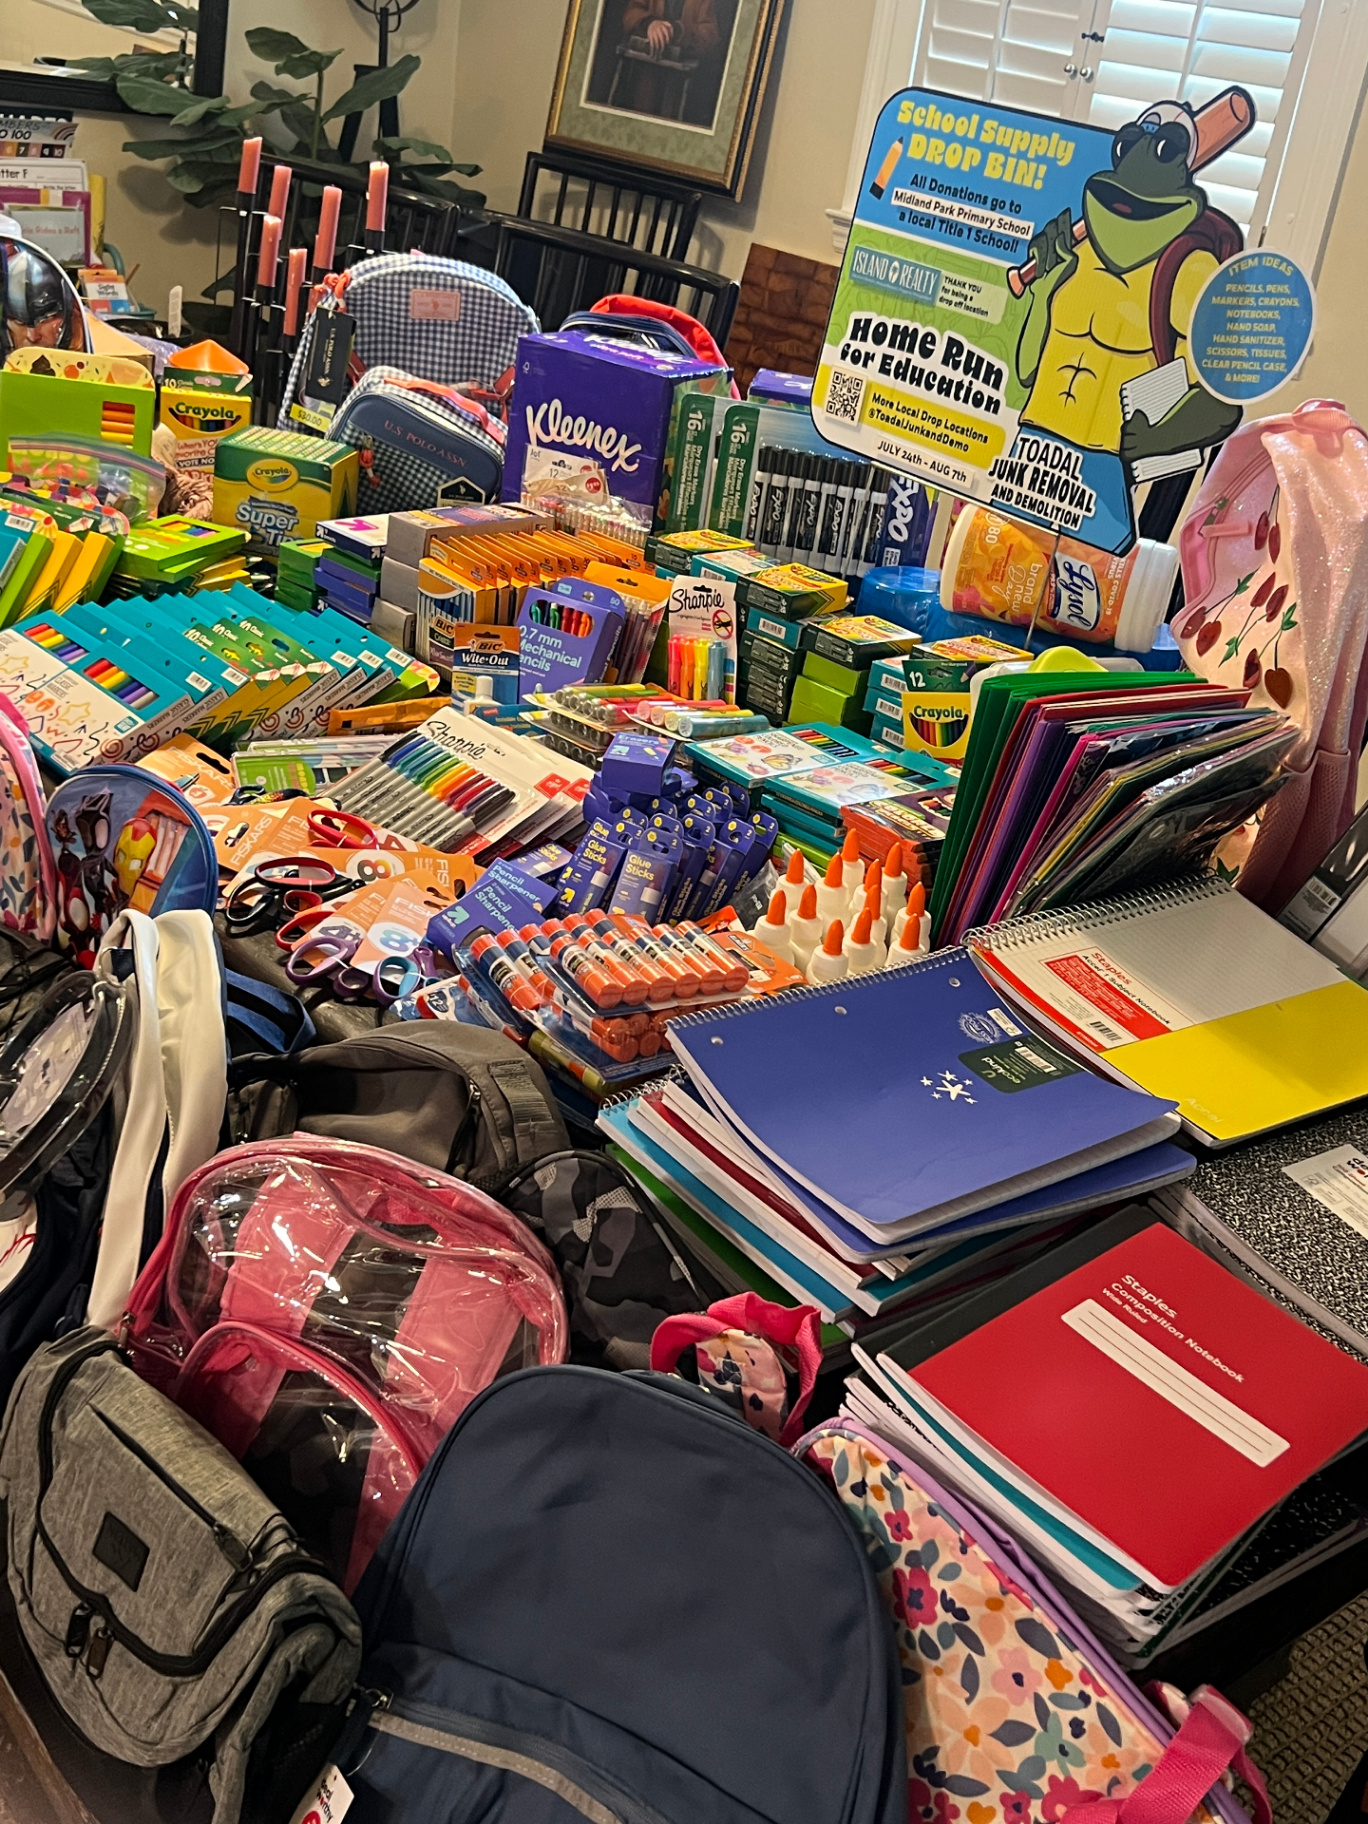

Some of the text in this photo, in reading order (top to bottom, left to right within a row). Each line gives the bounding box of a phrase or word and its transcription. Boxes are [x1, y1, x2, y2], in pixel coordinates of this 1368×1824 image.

[11, 130, 32, 140] 100
[897, 100, 1076, 166] School Supply
[19, 146, 26, 155] 7
[907, 133, 1048, 190] DROP BIN!
[22, 169, 28, 180] F
[910, 173, 1022, 215] All Donations go to
[894, 190, 1031, 236] Midland Park Primary School
[898, 211, 1019, 254] a local Title 1 School!
[852, 250, 888, 282] ISLAND
[899, 264, 938, 296] REALTY
[1229, 256, 1294, 276] ITEM IDEAS
[941, 285, 950, 294] for
[951, 289, 968, 301] being
[944, 276, 968, 290] THANK
[968, 282, 982, 294] YOU
[1226, 284, 1291, 294] PENCILS, PENS,
[939, 295, 989, 318] drop off location
[1212, 296, 1300, 307] MARKERS, CRAYONS,
[1226, 310, 1281, 320] NOTEBOOKS,
[1227, 323, 1276, 333] HAND SOAP,
[1213, 334, 1286, 346] HAND SANITIZER,
[849, 318, 1004, 392] Home Run
[1206, 347, 1287, 359] SCISSORS, TISSUES,
[1202, 359, 1288, 372] CLEAR PENCIL CASE,
[164, 378, 177, 388] 10
[840, 343, 1001, 416] for Education
[1224, 374, 1260, 383] & MORE!
[175, 402, 234, 420] Crayola
[298, 411, 322, 427] $30.00
[688, 410, 702, 431] 16
[872, 392, 990, 444] More Local Drop Locations
[526, 398, 642, 472] Kleenex
[730, 423, 746, 444] 16
[868, 408, 970, 452] @ToadalJunkandDemo
[406, 432, 436, 452] POLO
[178, 460, 199, 468] VOTE
[878, 440, 968, 483] JULY 24th AUG 7th
[1018, 437, 1082, 482] TOADAL
[254, 467, 290, 476] Crayola
[550, 468, 559, 479] 12
[989, 459, 1095, 514] JUNK REMOVAL
[236, 502, 298, 531] Super
[888, 476, 920, 542] EXPO
[992, 484, 1081, 530] AND DEMOLITION
[985, 526, 1001, 544] 80
[992, 564, 1026, 606] Day
[1023, 562, 1043, 604] brand
[1058, 560, 1096, 627] Lysol
[668, 588, 724, 613] Sharpie
[1012, 584, 1024, 612] new
[1106, 580, 1120, 616] COVID-19
[435, 618, 454, 634] BIC
[520, 625, 562, 649] 0.7 mm
[478, 642, 502, 652] BIC
[520, 654, 552, 672] encils
[908, 670, 926, 688] 12
[914, 705, 964, 721] Crayola
[426, 720, 486, 760] Sharpie
[618, 734, 660, 745] Erasers
[169, 746, 236, 790] FISKARS
[229, 815, 272, 866] FISKARS
[587, 840, 607, 854] Glue
[583, 849, 607, 866] Sticks
[628, 854, 652, 869] Glue
[493, 864, 525, 885] Pencil
[626, 864, 655, 881] Sticks
[488, 870, 542, 902] Sharpener
[482, 886, 512, 913] Pencil
[474, 892, 520, 933] Sharpene
[1091, 952, 1132, 986] Staples
[1082, 955, 1171, 1025] Accel Subject Notebook
[982, 1056, 1021, 1084] ecokind
[1102, 1288, 1149, 1325] Wide Ruled
[1121, 1274, 1178, 1319] Staples
[1111, 1282, 1246, 1384] Composition Notebook
[321, 1778, 333, 1801] deal
